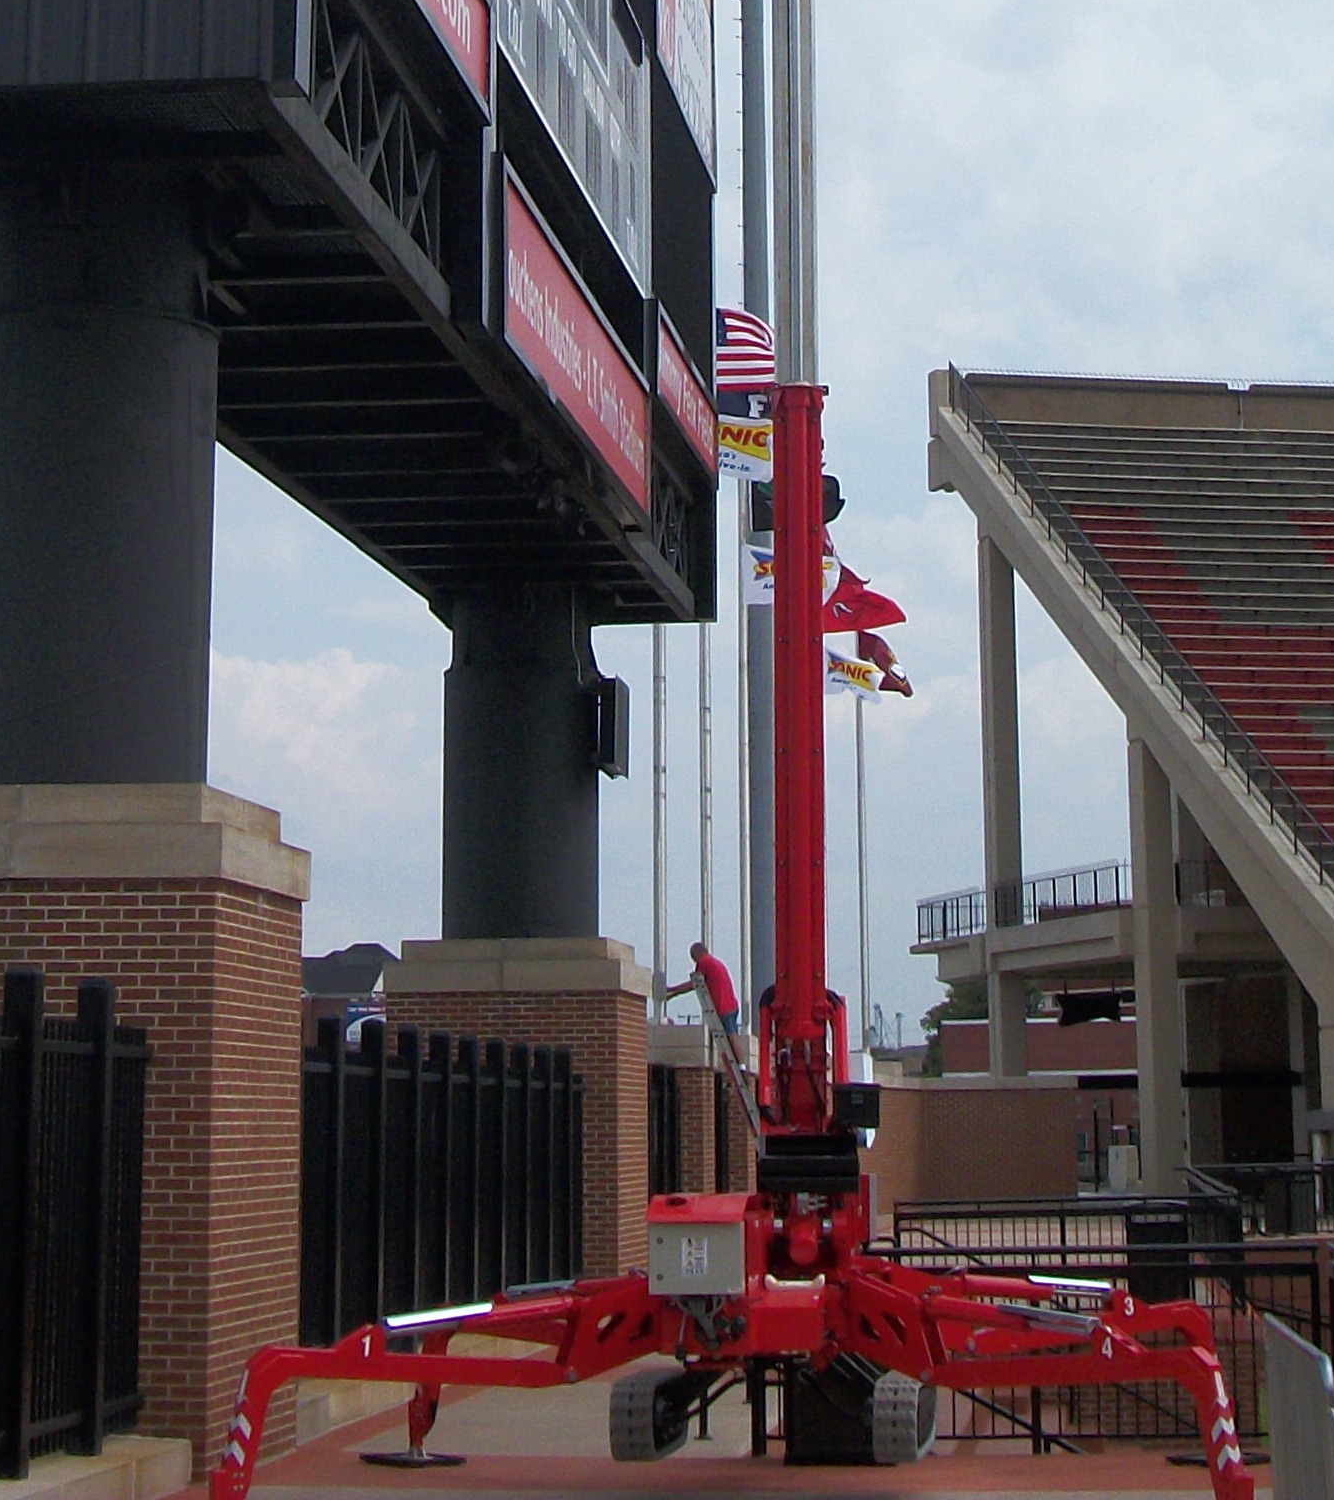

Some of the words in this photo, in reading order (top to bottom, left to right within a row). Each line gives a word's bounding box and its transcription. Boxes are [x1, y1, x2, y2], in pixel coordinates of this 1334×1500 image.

[508, 248, 543, 339] ouchens
[721, 426, 768, 447] NIC
[1124, 1297, 1134, 1316] 3
[361, 1335, 371, 1358] 1
[1101, 1337, 1113, 1359] 4
